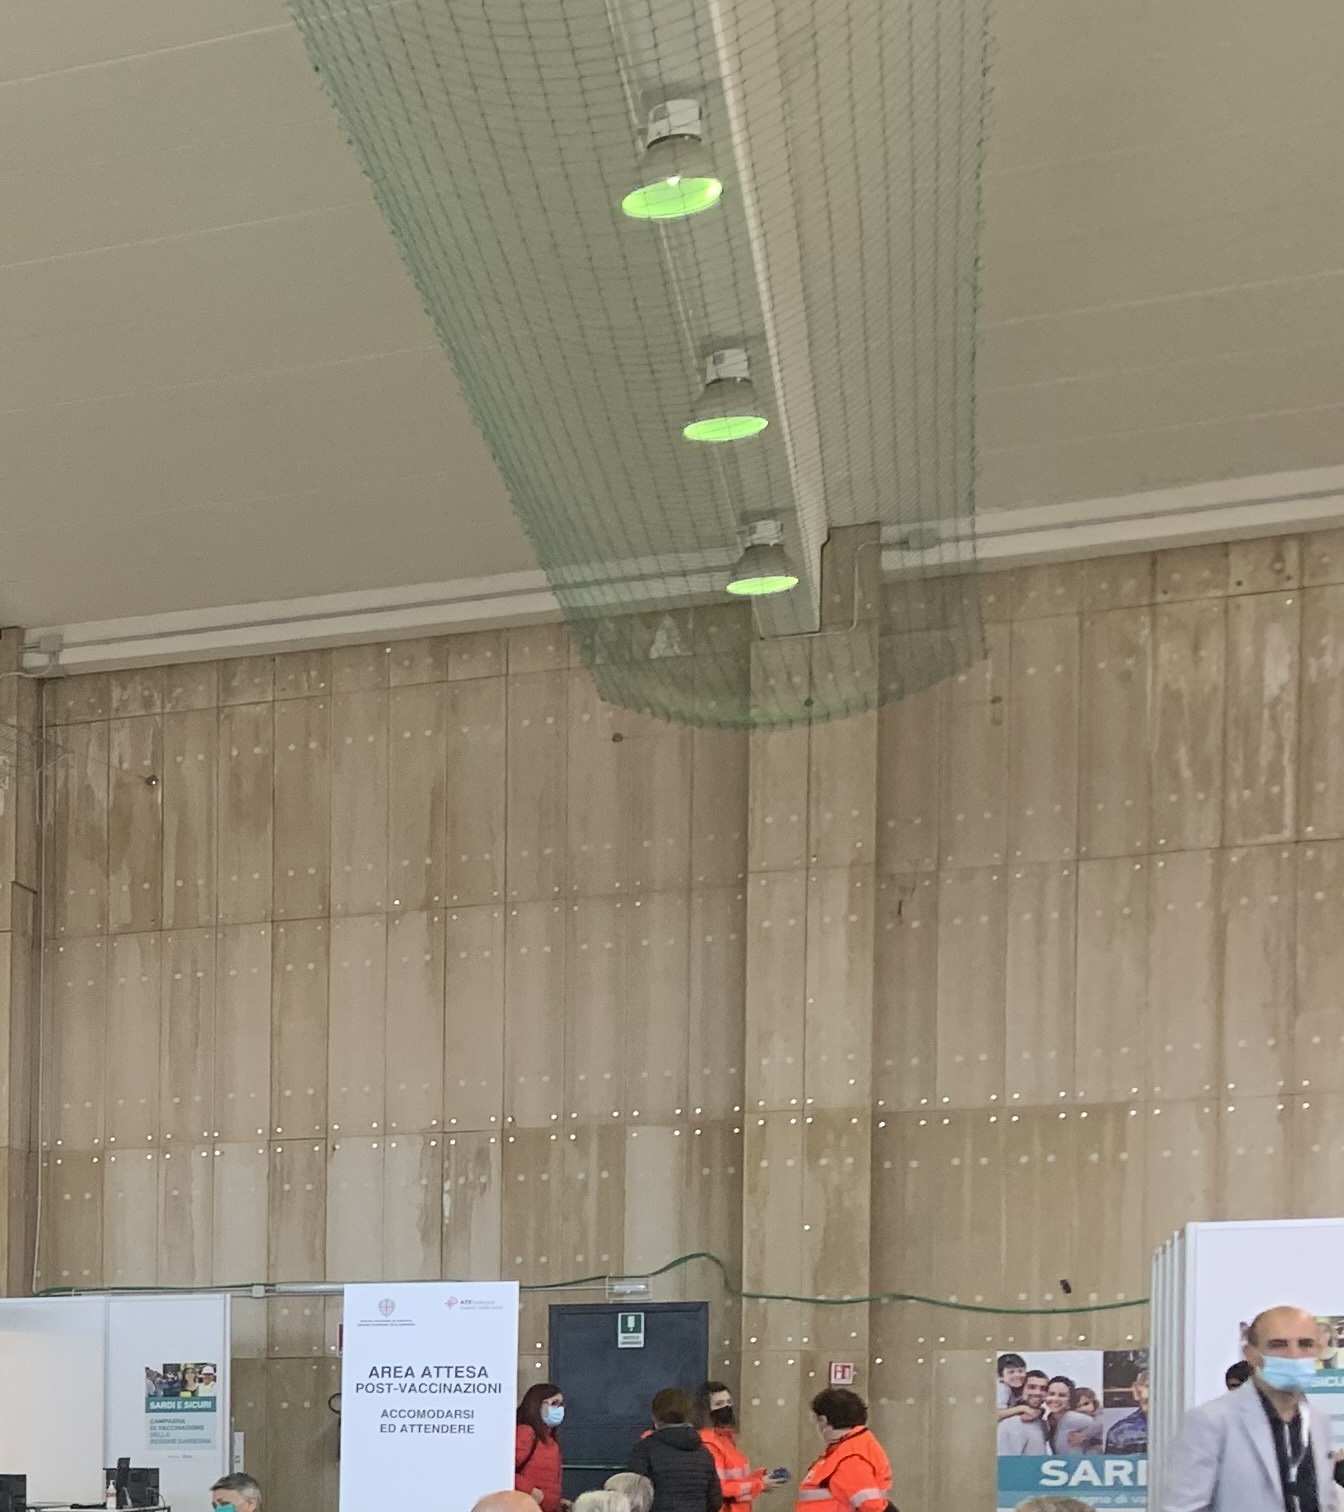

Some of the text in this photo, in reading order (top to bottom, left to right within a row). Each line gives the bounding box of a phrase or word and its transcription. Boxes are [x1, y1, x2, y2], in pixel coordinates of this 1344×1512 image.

[368, 1366, 489, 1379] AREA ATTESA
[355, 1382, 502, 1394] POST-VACCINAZIONI
[149, 1401, 176, 1410] SARDI
[183, 1400, 212, 1409] SICURI
[380, 1409, 475, 1419] ACCOMODARSI
[380, 1423, 475, 1434] ED ATTENDERE
